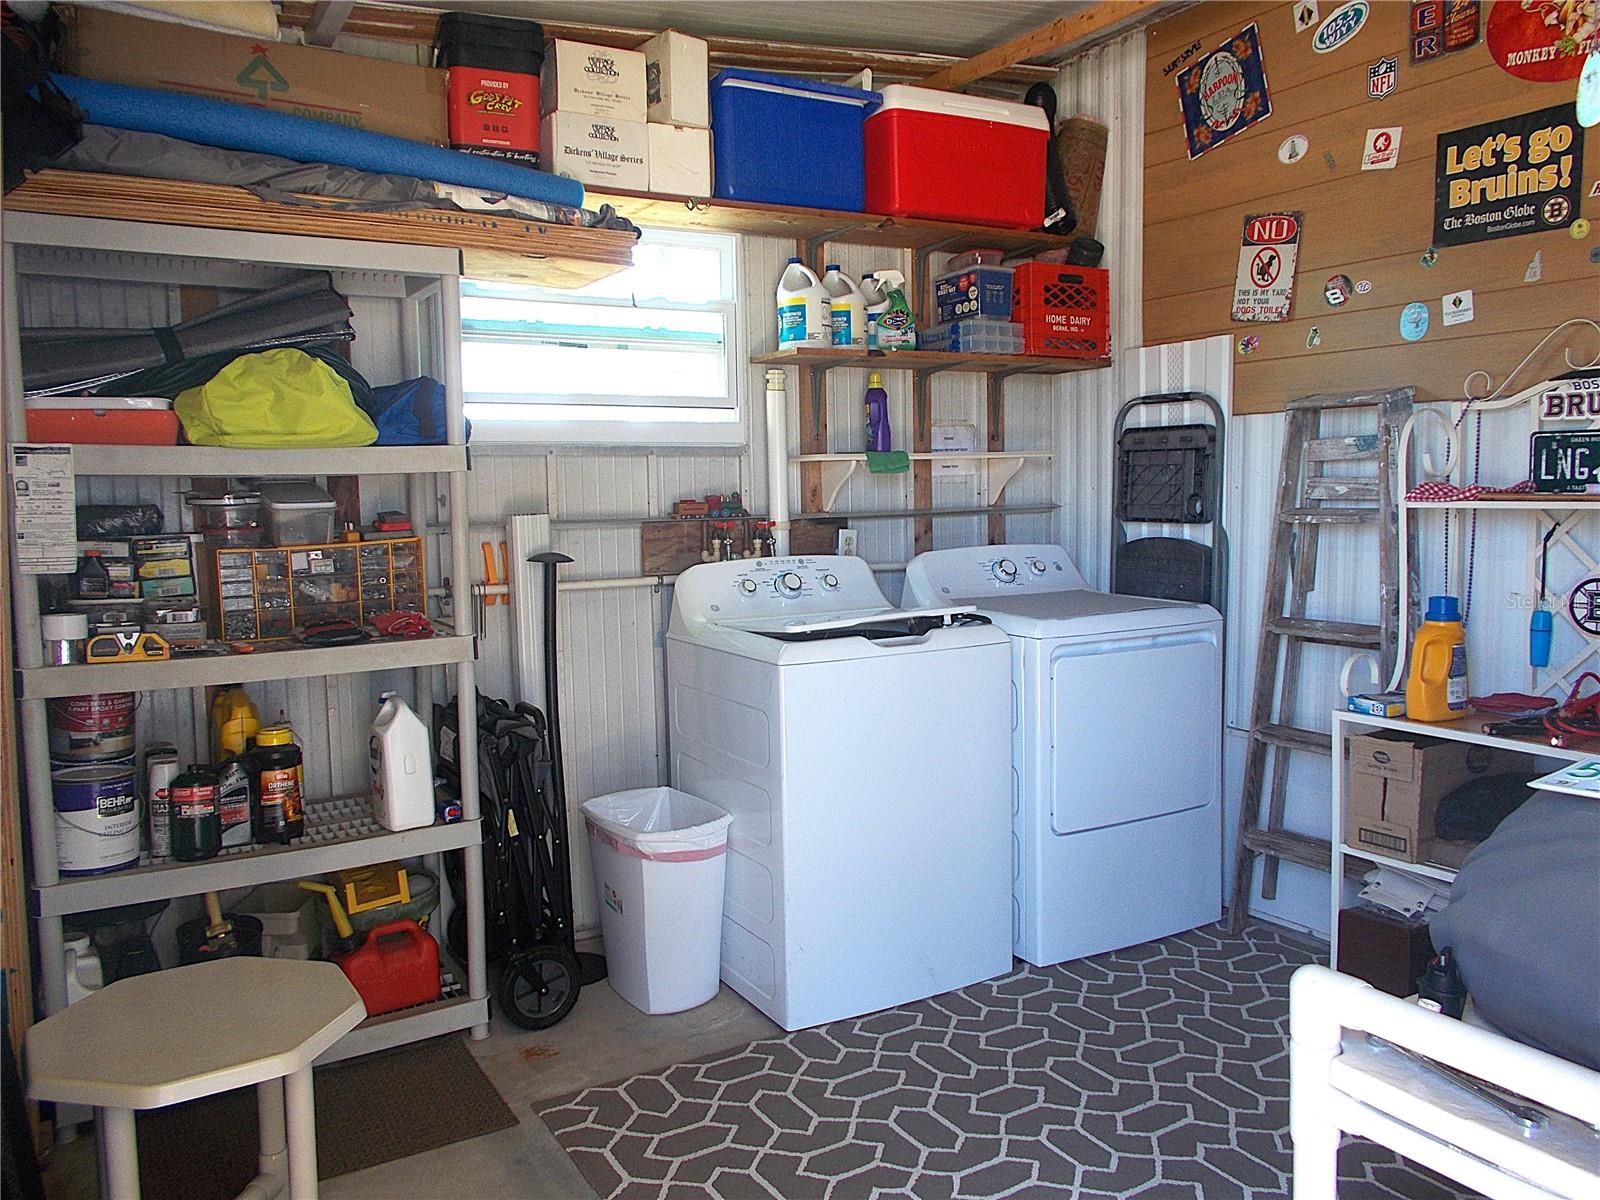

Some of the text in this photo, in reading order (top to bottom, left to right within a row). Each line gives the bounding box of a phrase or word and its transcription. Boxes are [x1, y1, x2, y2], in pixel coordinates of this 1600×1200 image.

[1506, 45, 1557, 67] MONKEY
[584, 66, 620, 77] COLLECTION
[480, 79, 502, 89] PROVIDED
[1203, 71, 1239, 102] HARPOON
[1371, 73, 1395, 95] NFL
[293, 107, 362, 128] COMPANY
[588, 133, 620, 142] COLLECTION
[594, 149, 619, 162] Village
[620, 154, 644, 165] Series
[1446, 124, 1573, 176] Let's go
[1449, 154, 1573, 210] Bruins!
[1443, 203, 1536, 231] The Boston Globe
[1253, 219, 1289, 241] NO
[1486, 219, 1536, 233] BostonGlobe.com
[1238, 288, 1287, 297] THIS IS MY YARD
[1236, 305, 1285, 314] DOGS TOILET
[1045, 314, 1091, 326] HOME DAIRY
[1572, 380, 1600, 391] BOS
[1540, 447, 1590, 480] LNG
[100, 795, 126, 809] BEHR
